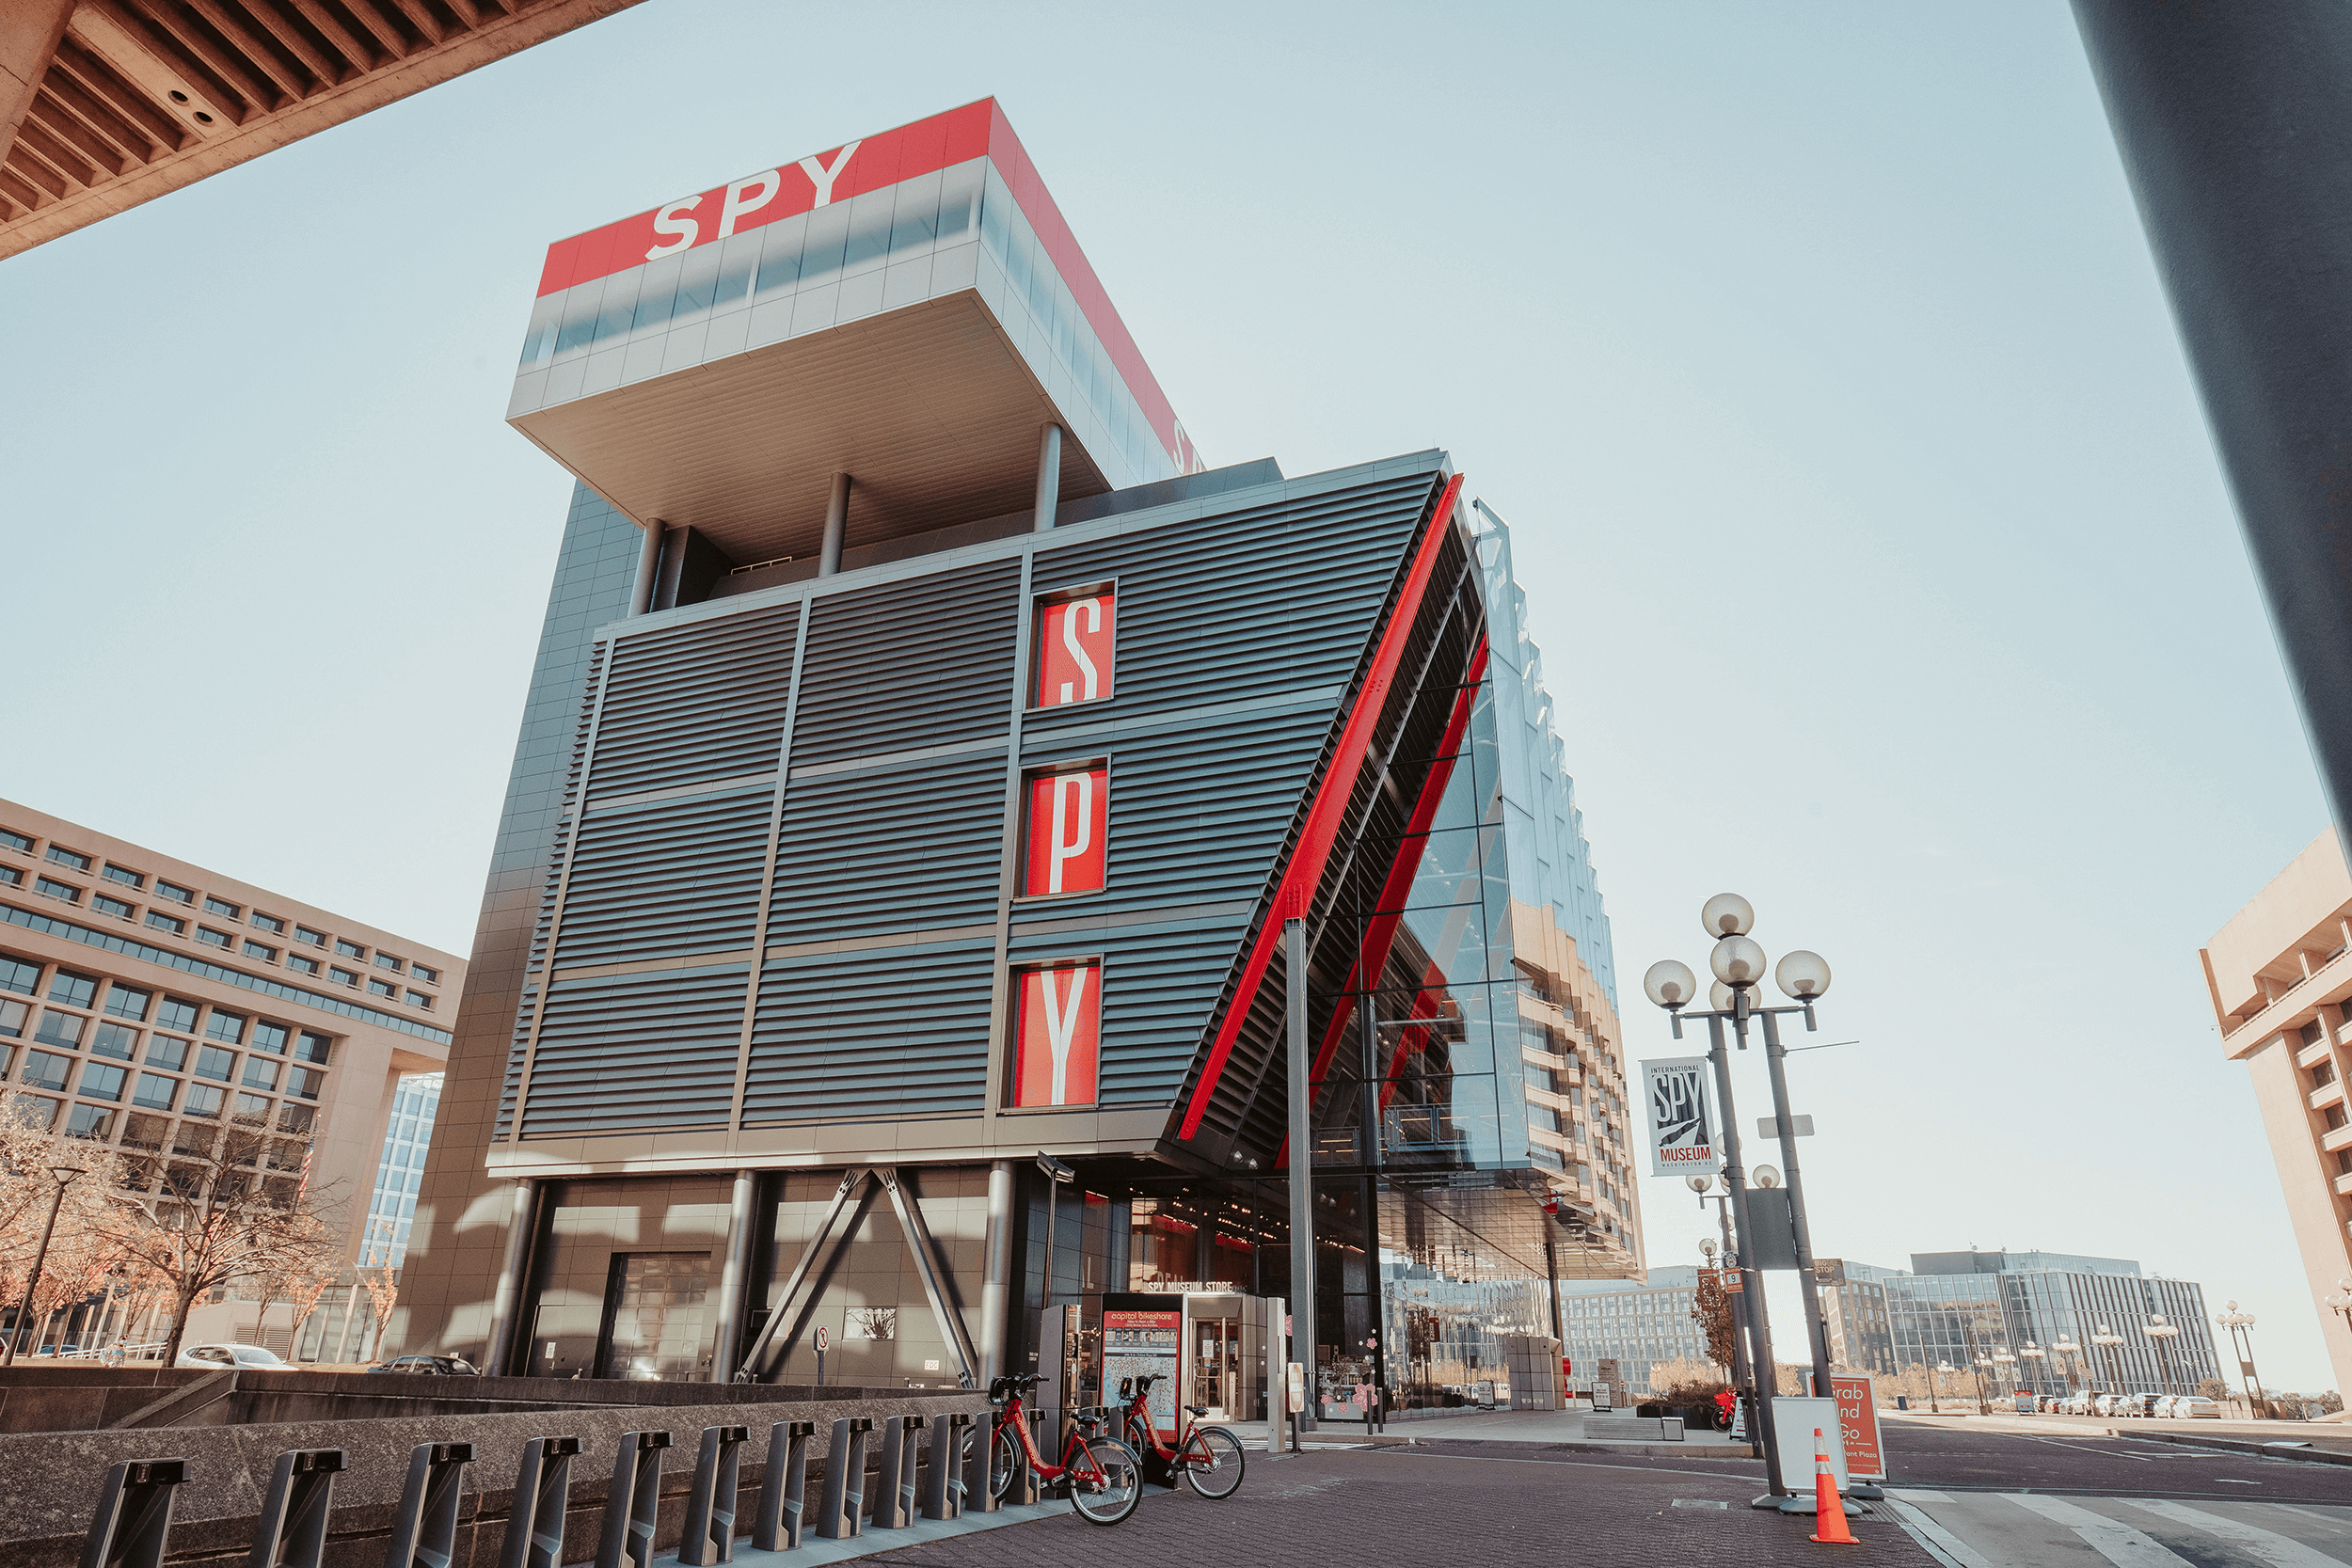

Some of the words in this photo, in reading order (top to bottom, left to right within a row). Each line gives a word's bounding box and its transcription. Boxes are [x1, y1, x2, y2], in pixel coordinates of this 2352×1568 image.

[644, 140, 862, 261] SPY
[1651, 1065, 1700, 1073] INTERNATIONAL
[1652, 1072, 1702, 1122] SPY
[1661, 1147, 1711, 1162] MUSEUM
[1148, 1281, 1165, 1292] SPY
[1167, 1281, 1203, 1292] MUSEUM
[1205, 1281, 1233, 1292] STORE
[1731, 1275, 1737, 1283] 9
[1111, 1312, 1136, 1321] capital
[1138, 1311, 1172, 1320] bikeshare
[1832, 1384, 1864, 1400] rab
[1840, 1402, 1860, 1418] nd
[1015, 1413, 1027, 1434] capital
[1859, 1450, 1878, 1459] Plaza
